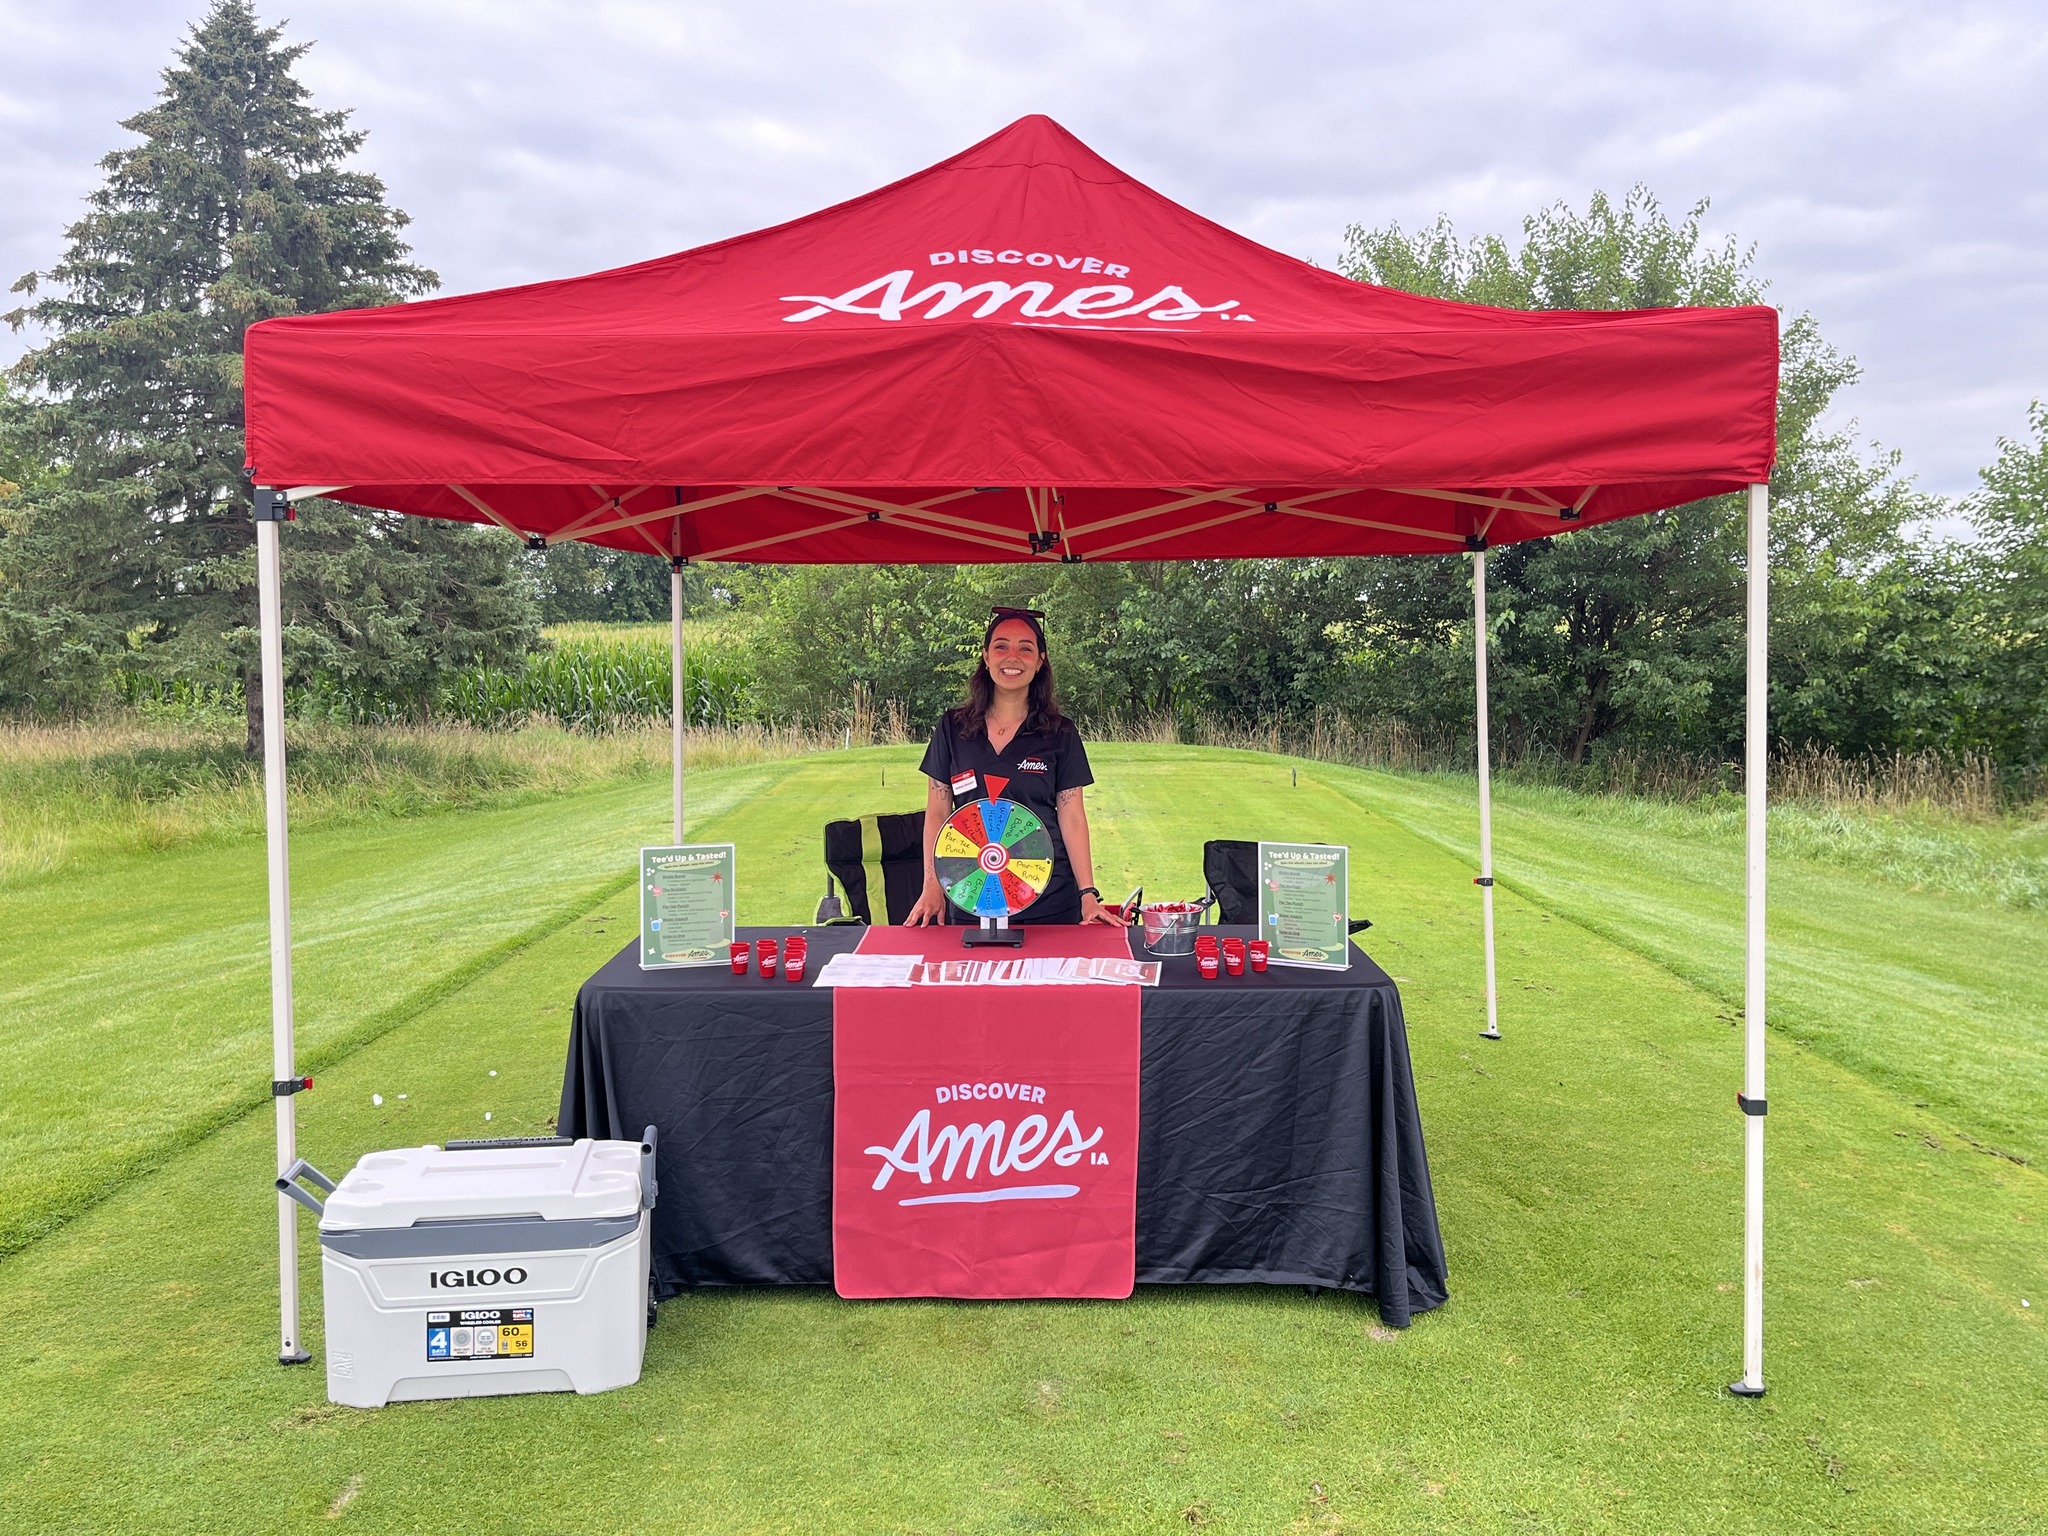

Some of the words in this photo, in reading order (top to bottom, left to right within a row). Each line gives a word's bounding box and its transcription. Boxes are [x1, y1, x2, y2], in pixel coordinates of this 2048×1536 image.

[930, 250, 1129, 278] DISCOVER
[779, 270, 1240, 322] Ames
[1220, 313, 1256, 322] IA
[1017, 759, 1046, 770] Ames
[996, 807, 1006, 832] Water
[1006, 818, 1022, 838] Bomb
[651, 855, 673, 863] Tee'd
[695, 851, 726, 860] Tasted!
[946, 846, 966, 854] Punch
[1290, 852, 1301, 860] Up
[1310, 852, 1340, 860] Tasted!
[1022, 872, 1040, 882] Punch
[958, 881, 972, 900] Bomb
[936, 1082, 1046, 1104] DISCOVER
[864, 1109, 1104, 1190] Ames
[1090, 1152, 1110, 1165] IA
[430, 1267, 528, 1288] IGLOO
[461, 1311, 500, 1320] IGLOO
[430, 1332, 447, 1348] 4
[502, 1327, 520, 1336] 60
